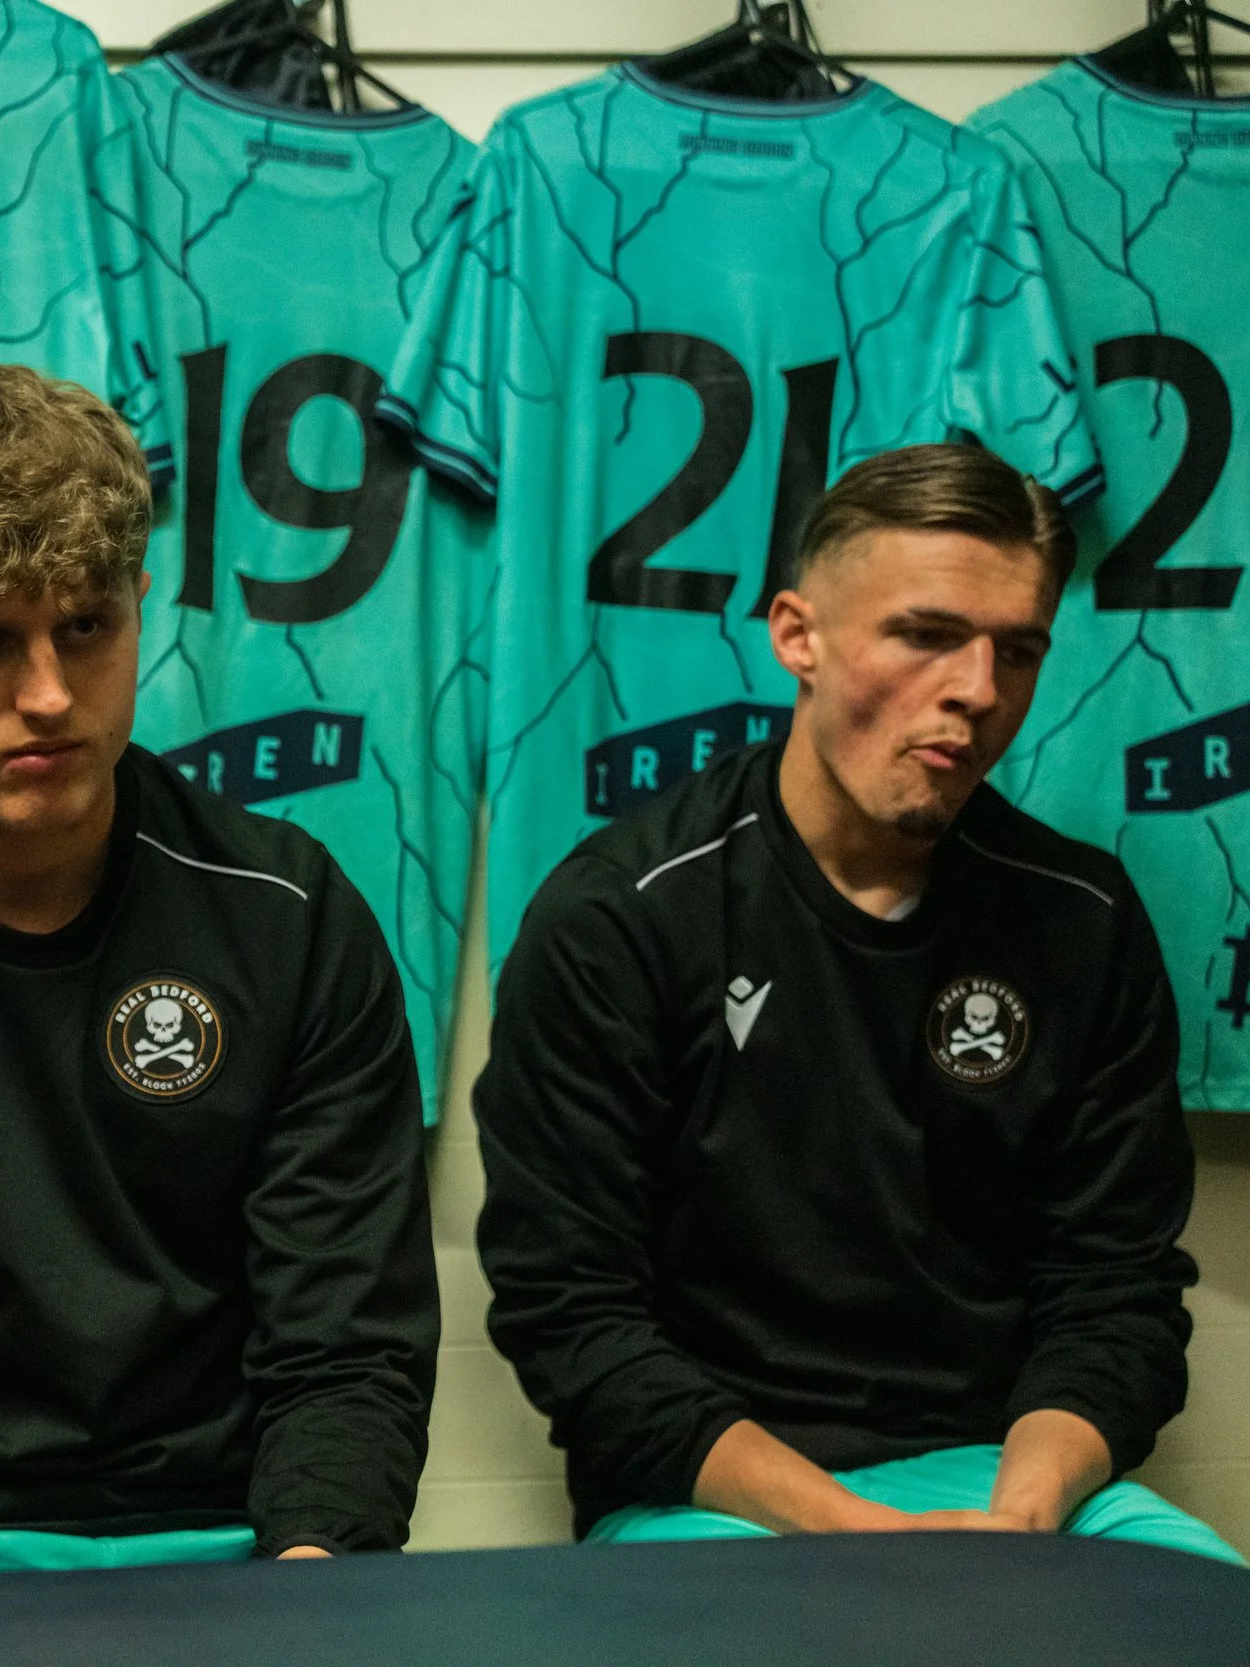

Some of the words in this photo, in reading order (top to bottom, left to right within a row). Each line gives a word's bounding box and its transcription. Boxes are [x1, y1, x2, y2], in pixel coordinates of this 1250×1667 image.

[174, 344, 411, 624] 19
[586, 332, 840, 620] 21
[1144, 735, 1231, 801] IR
[115, 992, 146, 1023] REAL
[150, 984, 213, 1024] BEDFORD
